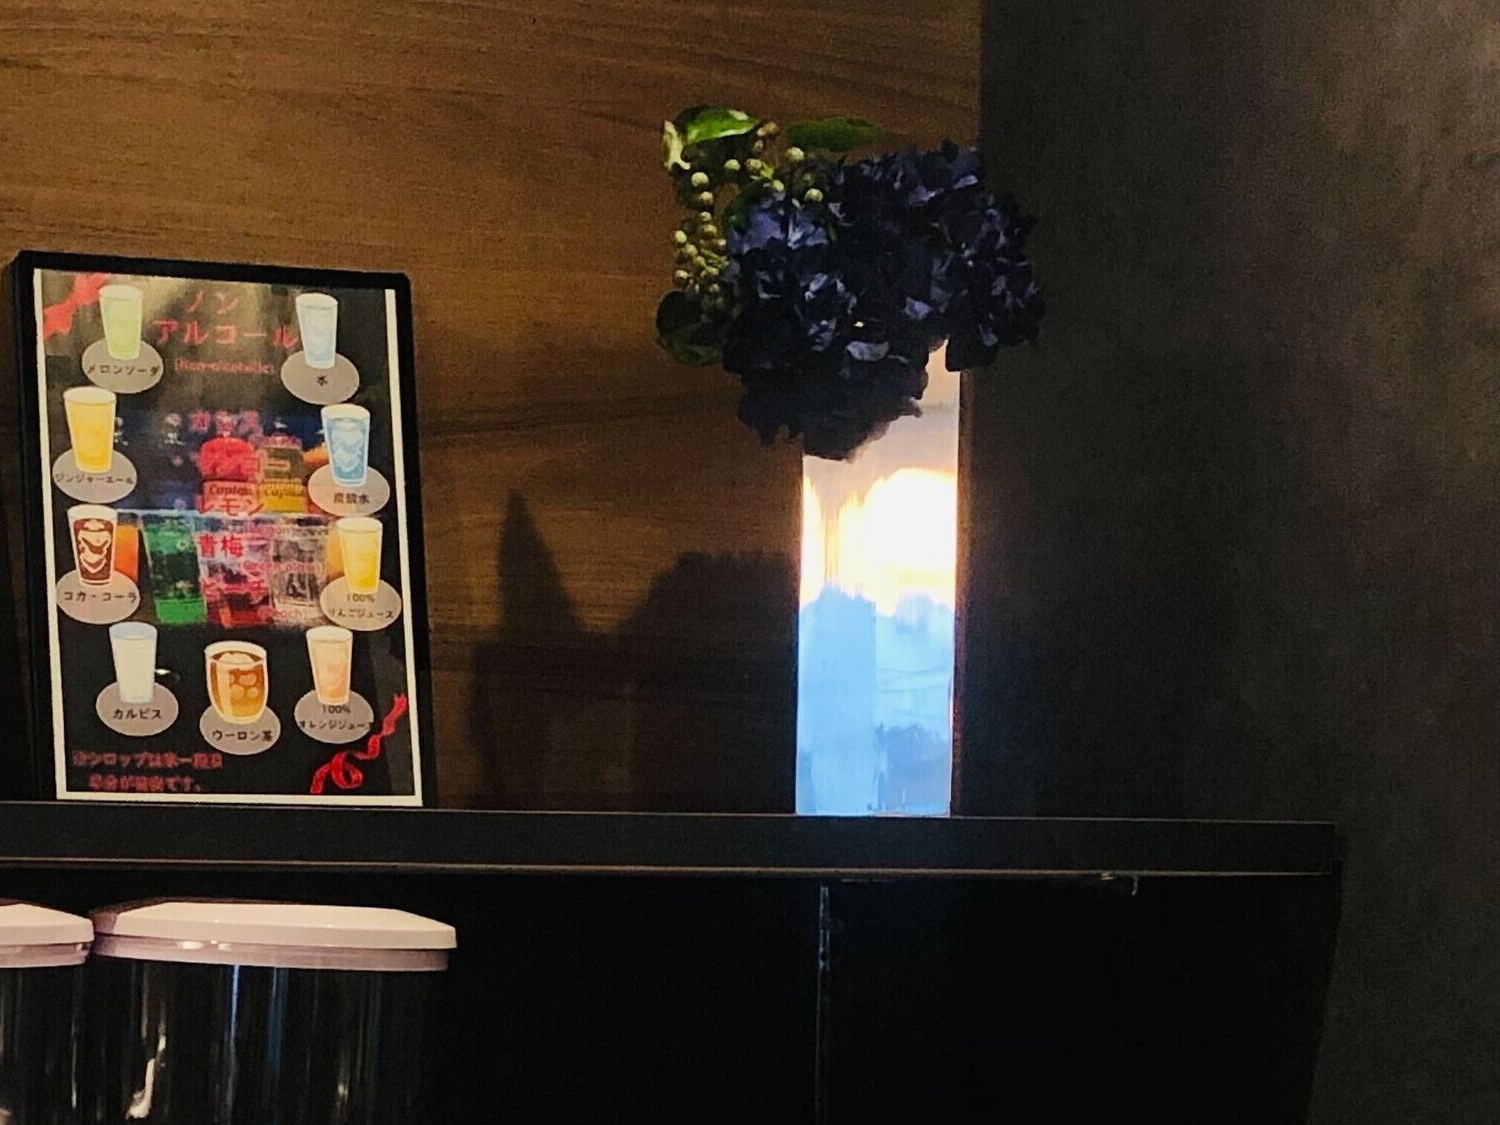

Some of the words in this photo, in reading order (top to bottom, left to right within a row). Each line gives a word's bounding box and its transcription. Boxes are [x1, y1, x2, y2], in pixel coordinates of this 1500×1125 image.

[185, 290, 238, 316] ノン
[151, 318, 299, 350] アルコール
[86, 362, 159, 377] メロンソーダ
[316, 374, 329, 388] 水
[62, 589, 138, 605] コカ・コーラ
[112, 706, 163, 721] カルピス
